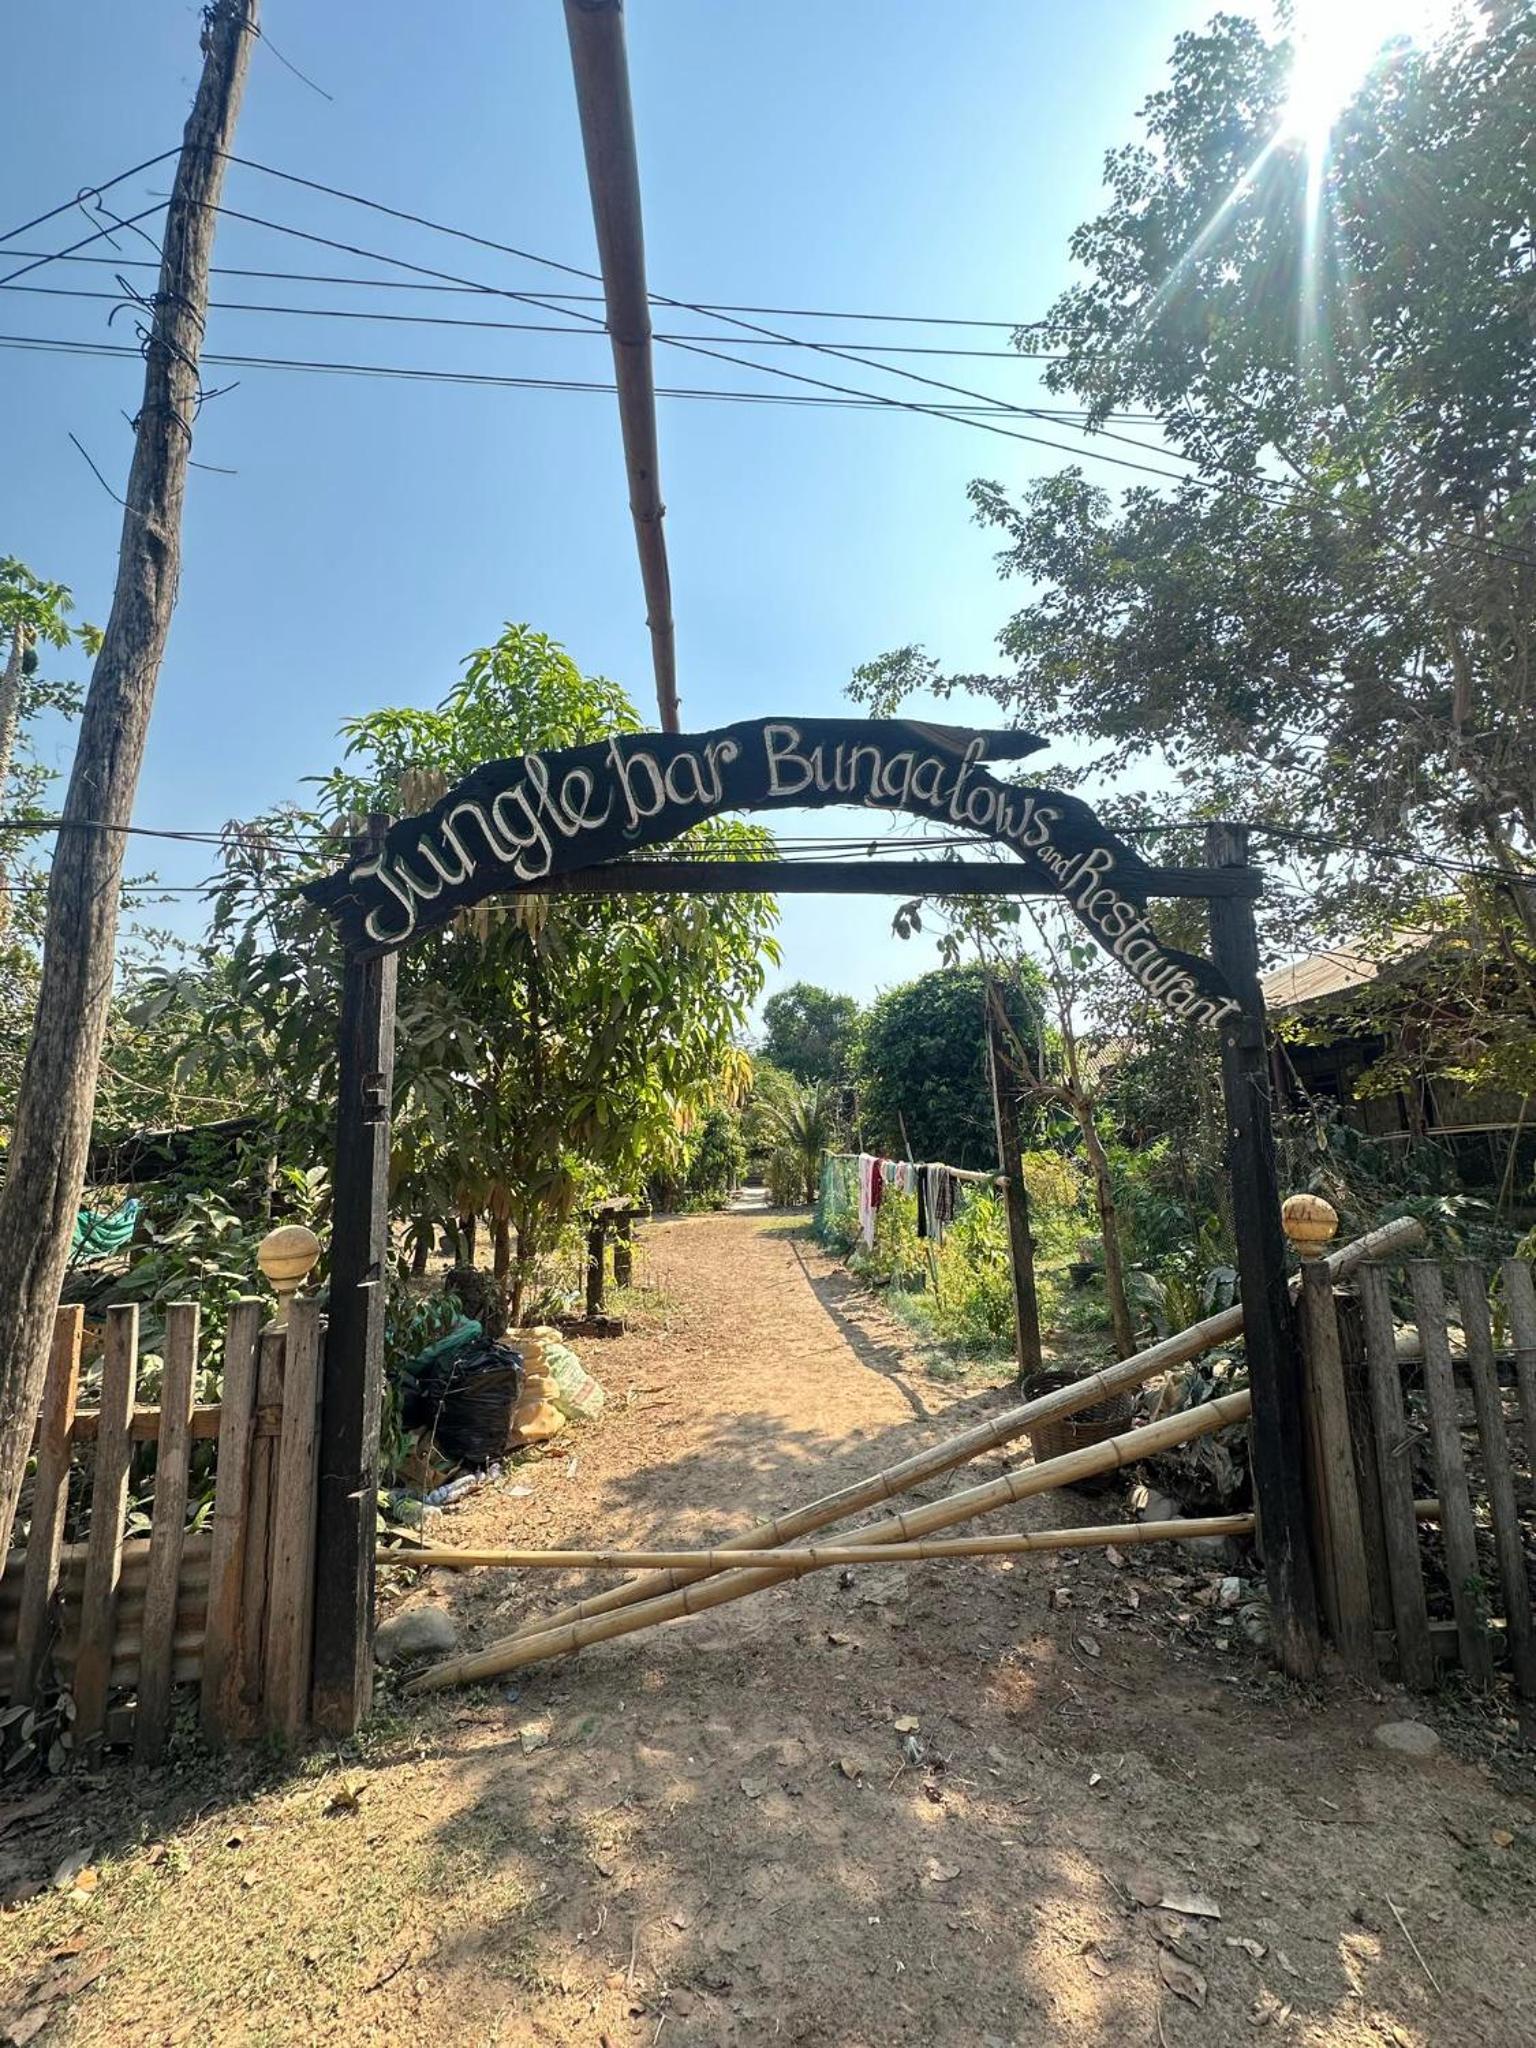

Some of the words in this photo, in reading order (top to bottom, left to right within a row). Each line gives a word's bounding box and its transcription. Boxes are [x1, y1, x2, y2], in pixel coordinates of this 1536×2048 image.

[350, 754, 613, 944] Jungle
[604, 736, 738, 831] bar
[763, 724, 1060, 847] Bungalows
[1036, 845, 1083, 882] and
[1061, 847, 1242, 1028] Restaurant
